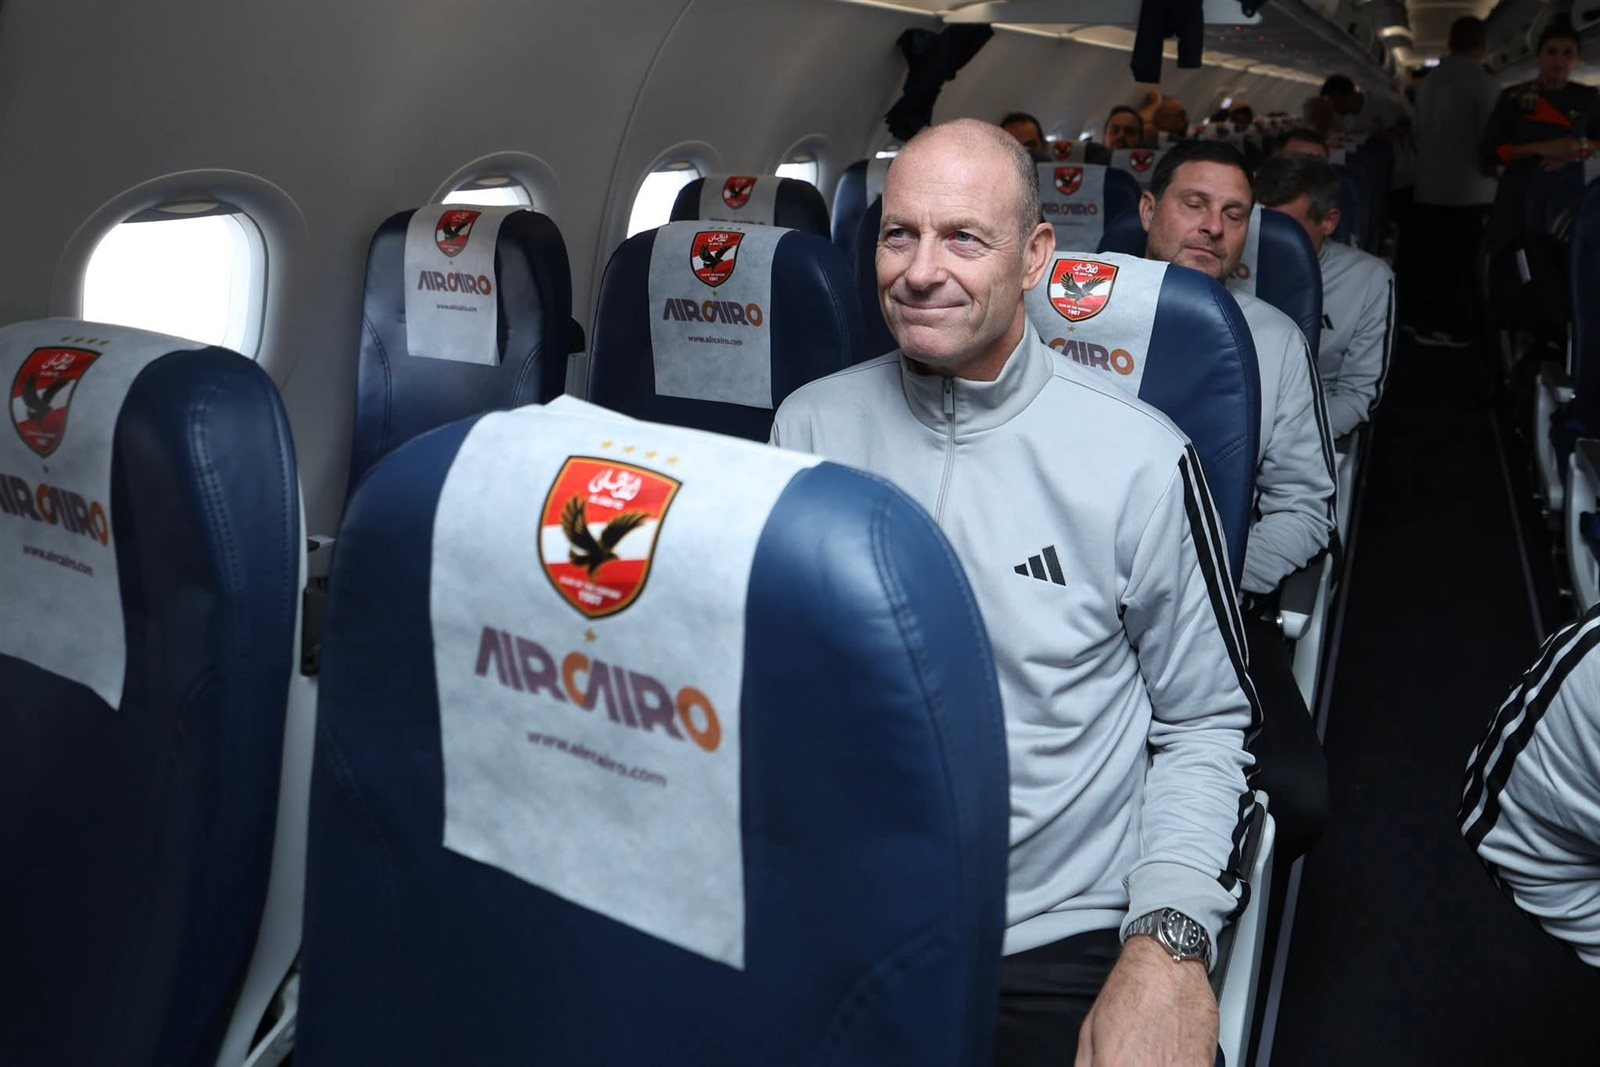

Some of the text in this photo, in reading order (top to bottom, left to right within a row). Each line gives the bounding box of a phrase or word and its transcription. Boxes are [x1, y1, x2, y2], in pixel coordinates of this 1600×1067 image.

[663, 298, 763, 327] AIRCAIRO
[688, 335, 743, 346] www.aircairo.com
[474, 625, 722, 753] AIRCAIRO
[526, 730, 668, 788] www.aircairo.com
